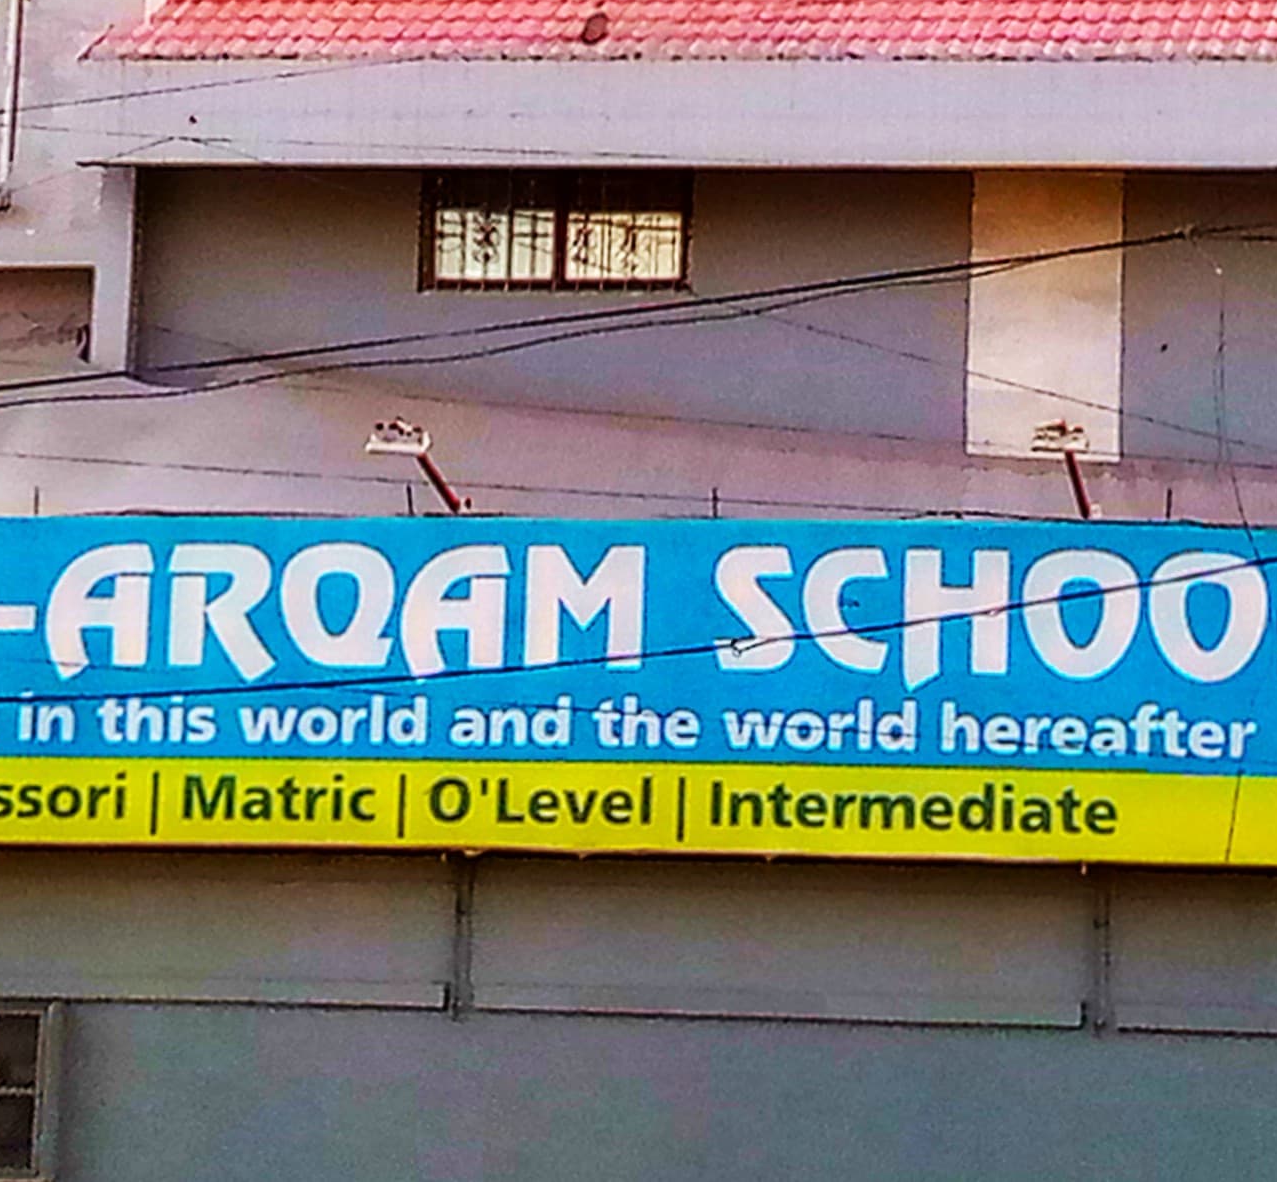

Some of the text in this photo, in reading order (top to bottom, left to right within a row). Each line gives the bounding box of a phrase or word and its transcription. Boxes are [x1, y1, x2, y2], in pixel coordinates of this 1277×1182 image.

[15, 693, 76, 744] in
[96, 695, 217, 744] this
[238, 694, 427, 745] world
[449, 695, 573, 747] and
[592, 695, 701, 748] the
[723, 698, 918, 754] world
[940, 700, 1260, 761] hereafter
[181, 772, 378, 823] Matric
[427, 775, 654, 827] O'Level
[709, 780, 1119, 836] Intermediate
